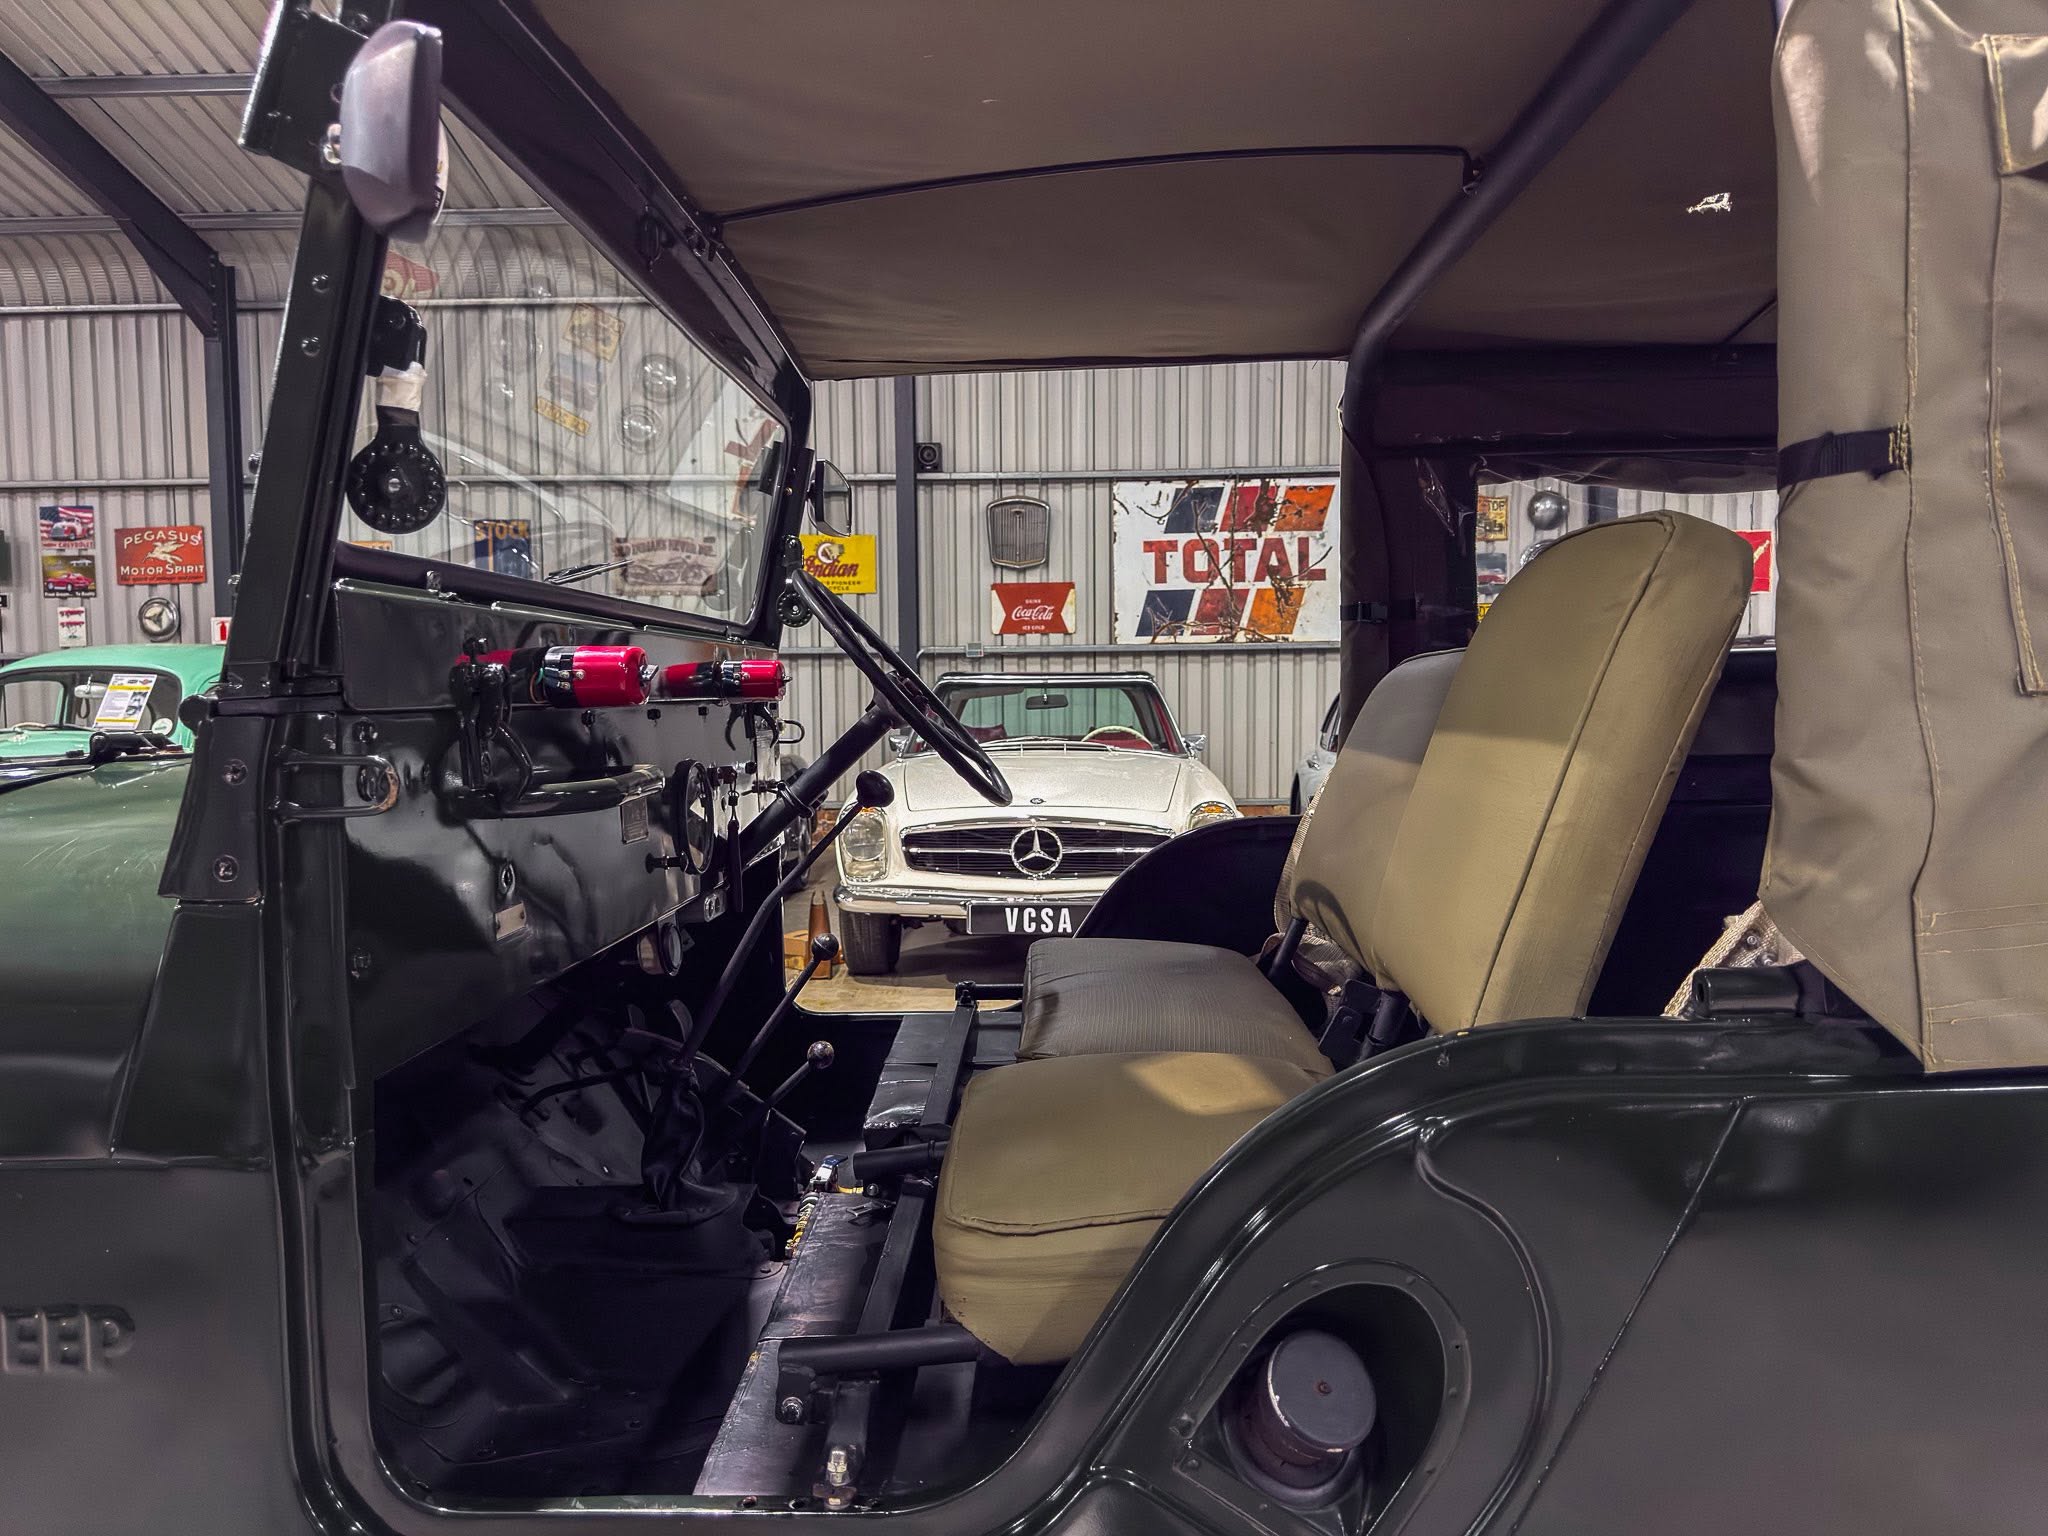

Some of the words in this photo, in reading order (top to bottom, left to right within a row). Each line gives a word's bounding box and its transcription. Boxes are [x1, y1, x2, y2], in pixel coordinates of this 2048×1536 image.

[123, 530, 201, 549] PEGASUS
[475, 521, 529, 541] STOCK
[120, 565, 163, 575] MOTOR
[166, 563, 204, 575] SPIRIT
[805, 555, 859, 578] Indian
[1143, 537, 1327, 584] TOTAL
[1011, 605, 1055, 621] Coca-Cola
[1004, 907, 1073, 933] VCSA
[0, 1304, 136, 1373] EEP
